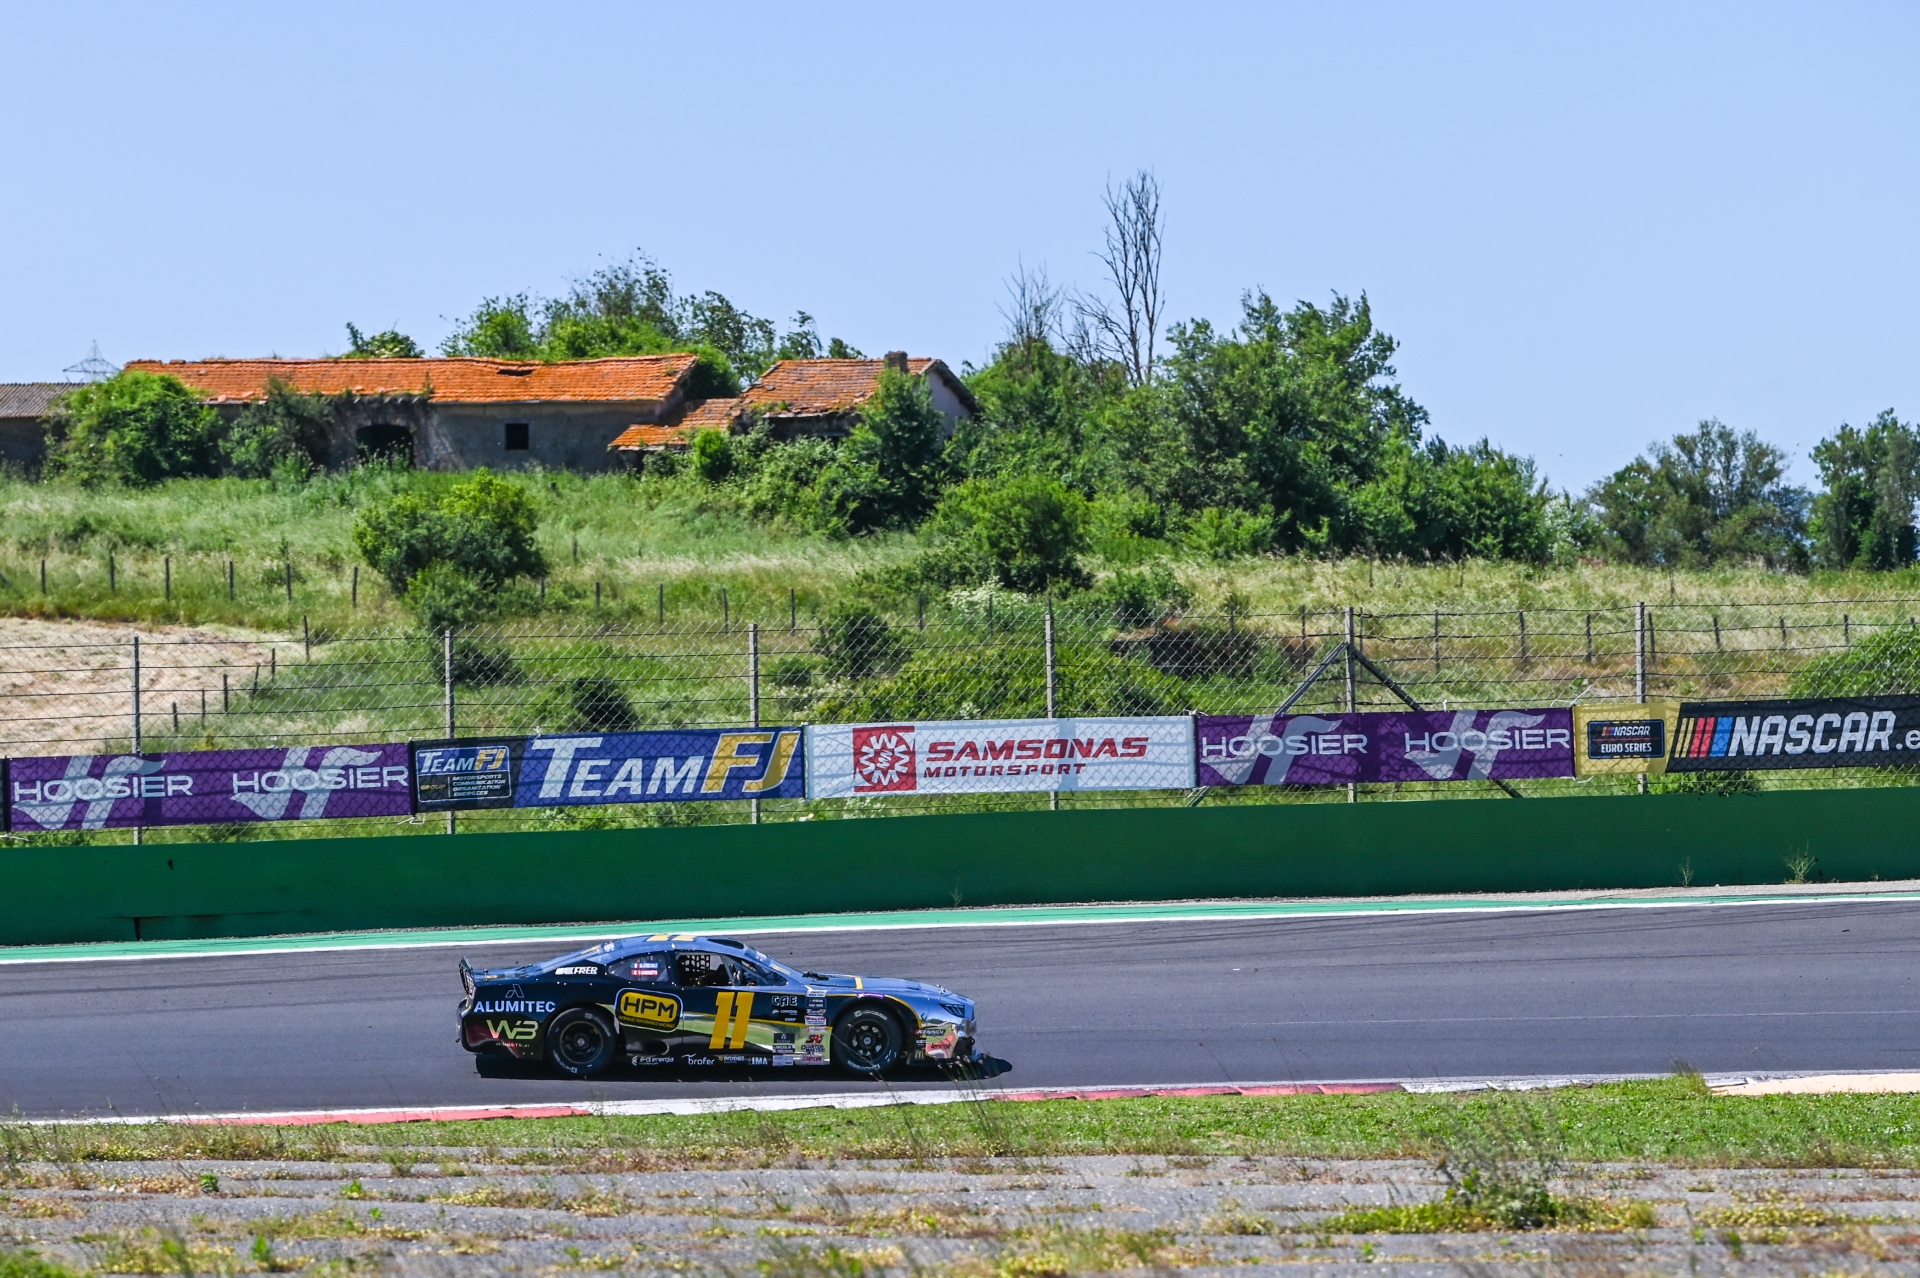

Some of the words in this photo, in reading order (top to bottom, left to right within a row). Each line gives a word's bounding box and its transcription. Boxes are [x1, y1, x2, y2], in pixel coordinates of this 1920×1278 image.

[1404, 728, 1571, 752] HOOSIER
[1613, 726, 1651, 736] NASCAR
[925, 737, 1149, 762] SAMSONAS
[1202, 733, 1368, 757] HOOSIER
[1601, 744, 1623, 753] EURO
[1625, 743, 1652, 752] SERIES
[232, 766, 409, 794] HOOSIER
[923, 763, 1086, 778] MOTORSPORT
[13, 775, 194, 802] HOOSIER
[473, 1000, 556, 1013] ALUMITEC
[623, 995, 675, 1019] HPM
[771, 995, 798, 1007] CAE
[709, 992, 754, 1049] 11
